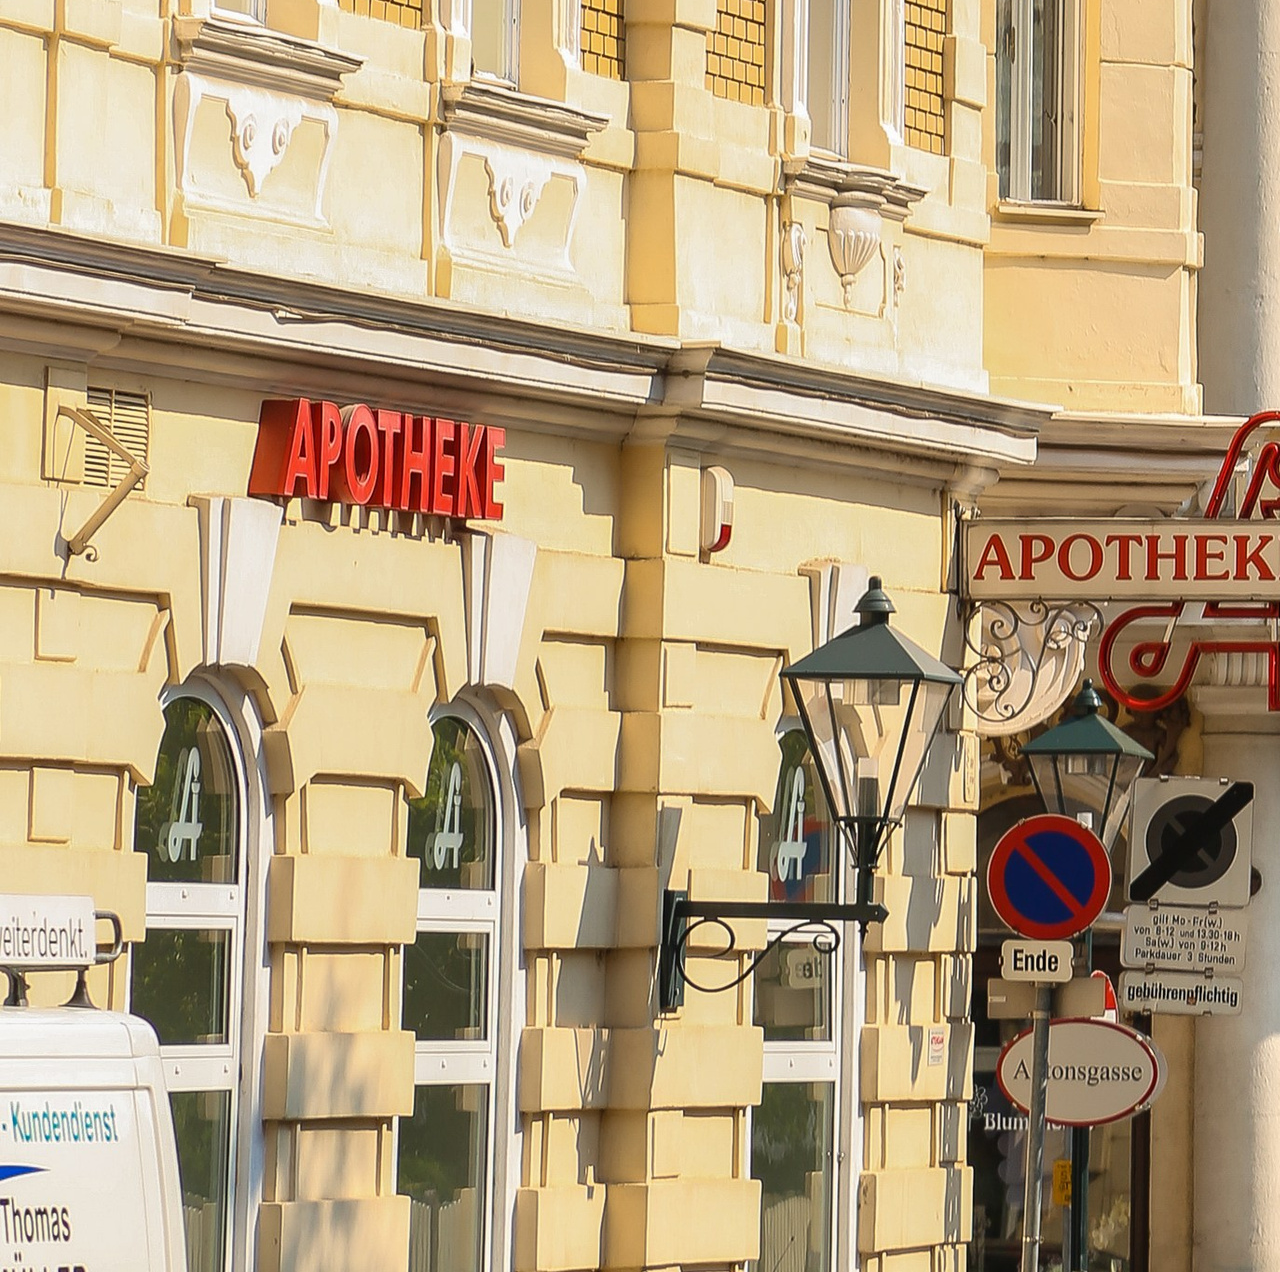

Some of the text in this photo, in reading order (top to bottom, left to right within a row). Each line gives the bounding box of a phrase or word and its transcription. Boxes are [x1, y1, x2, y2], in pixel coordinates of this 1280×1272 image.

[283, 397, 506, 521] APOTHEKE
[0, 916, 88, 958] eiterdenkt.
[1134, 926, 1151, 935] von
[1180, 930, 1195, 939] und
[1179, 941, 1195, 950] von
[1012, 948, 1059, 973] Ende
[1135, 948, 1236, 965] Parkdauer 3 Stunden
[1127, 982, 1238, 1007] gebührenpflichtig
[1013, 1058, 1143, 1087] Aonsgasse
[10, 1101, 119, 1142] Kundendienst
[0, 1197, 71, 1243] Thomas
